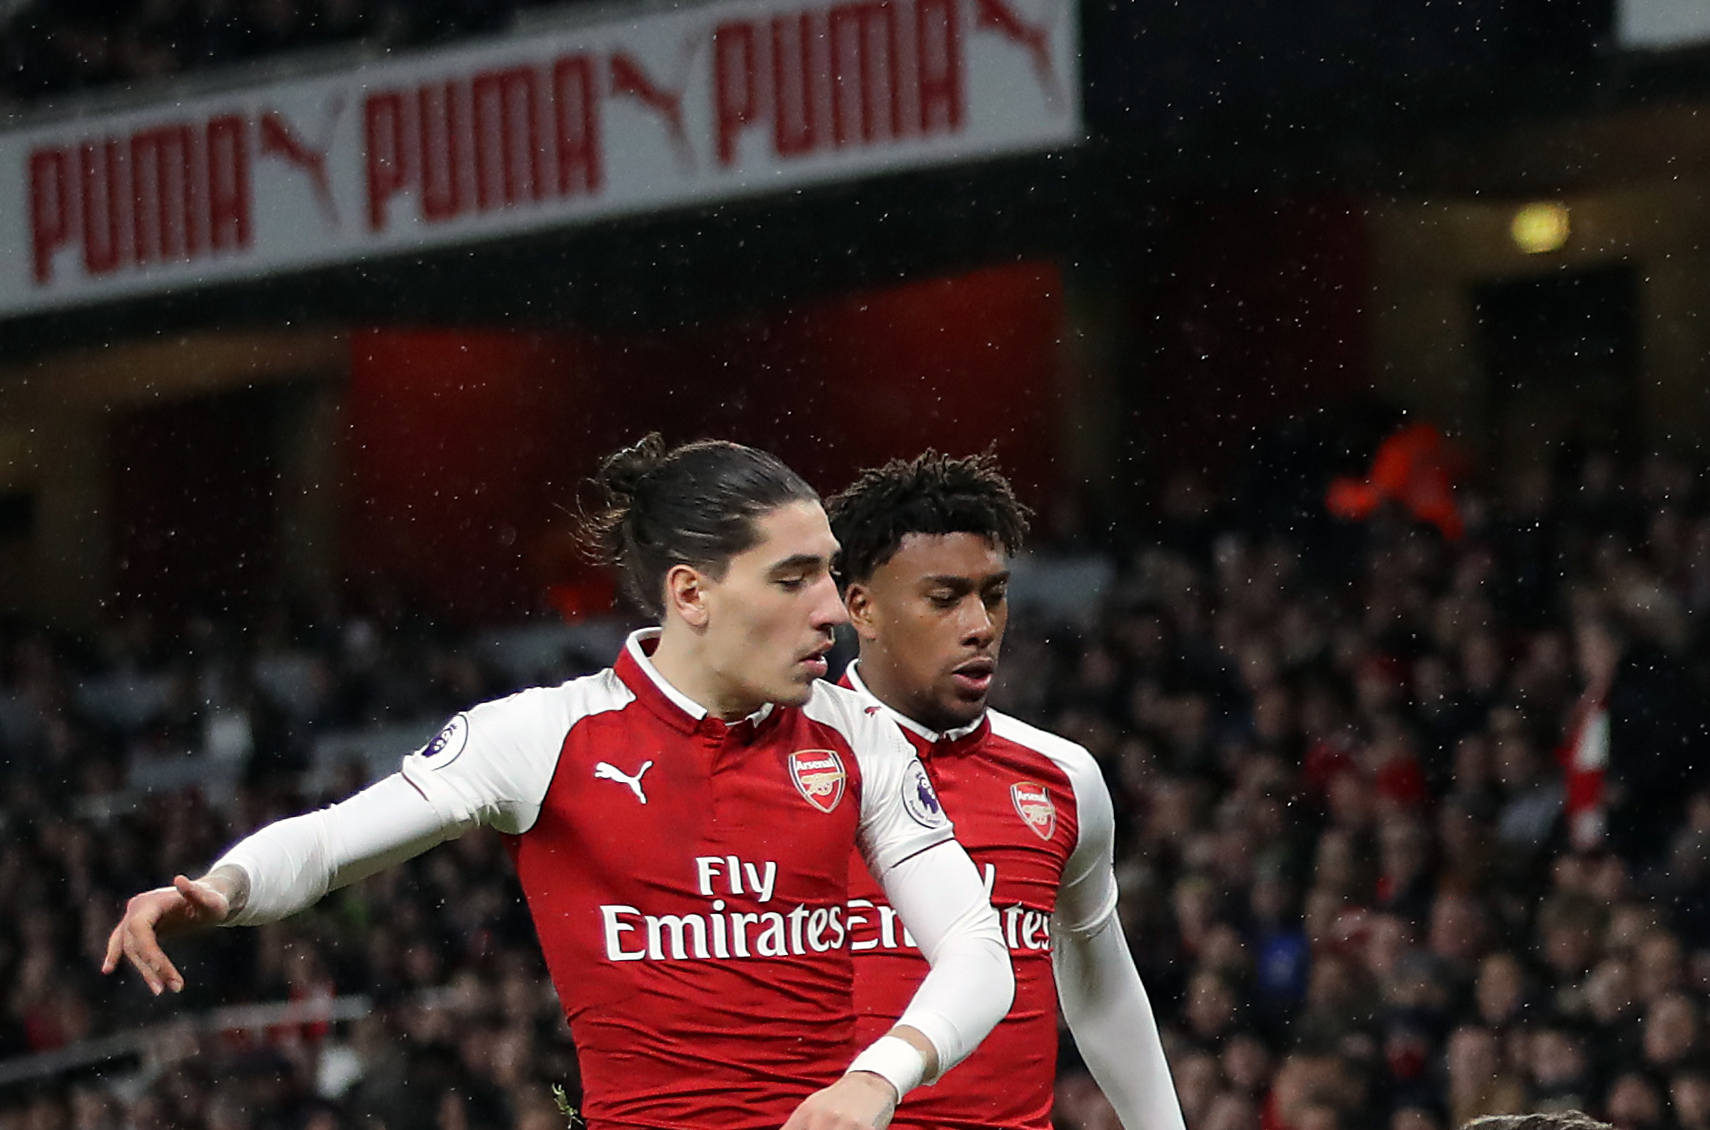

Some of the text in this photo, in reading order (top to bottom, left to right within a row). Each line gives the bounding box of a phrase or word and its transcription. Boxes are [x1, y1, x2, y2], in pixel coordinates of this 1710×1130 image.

[30, 0, 965, 286] PUMA PUMA PUMA
[796, 757, 836, 770] Arsenal
[696, 856, 777, 902] Fly
[600, 900, 845, 961] Emirates
